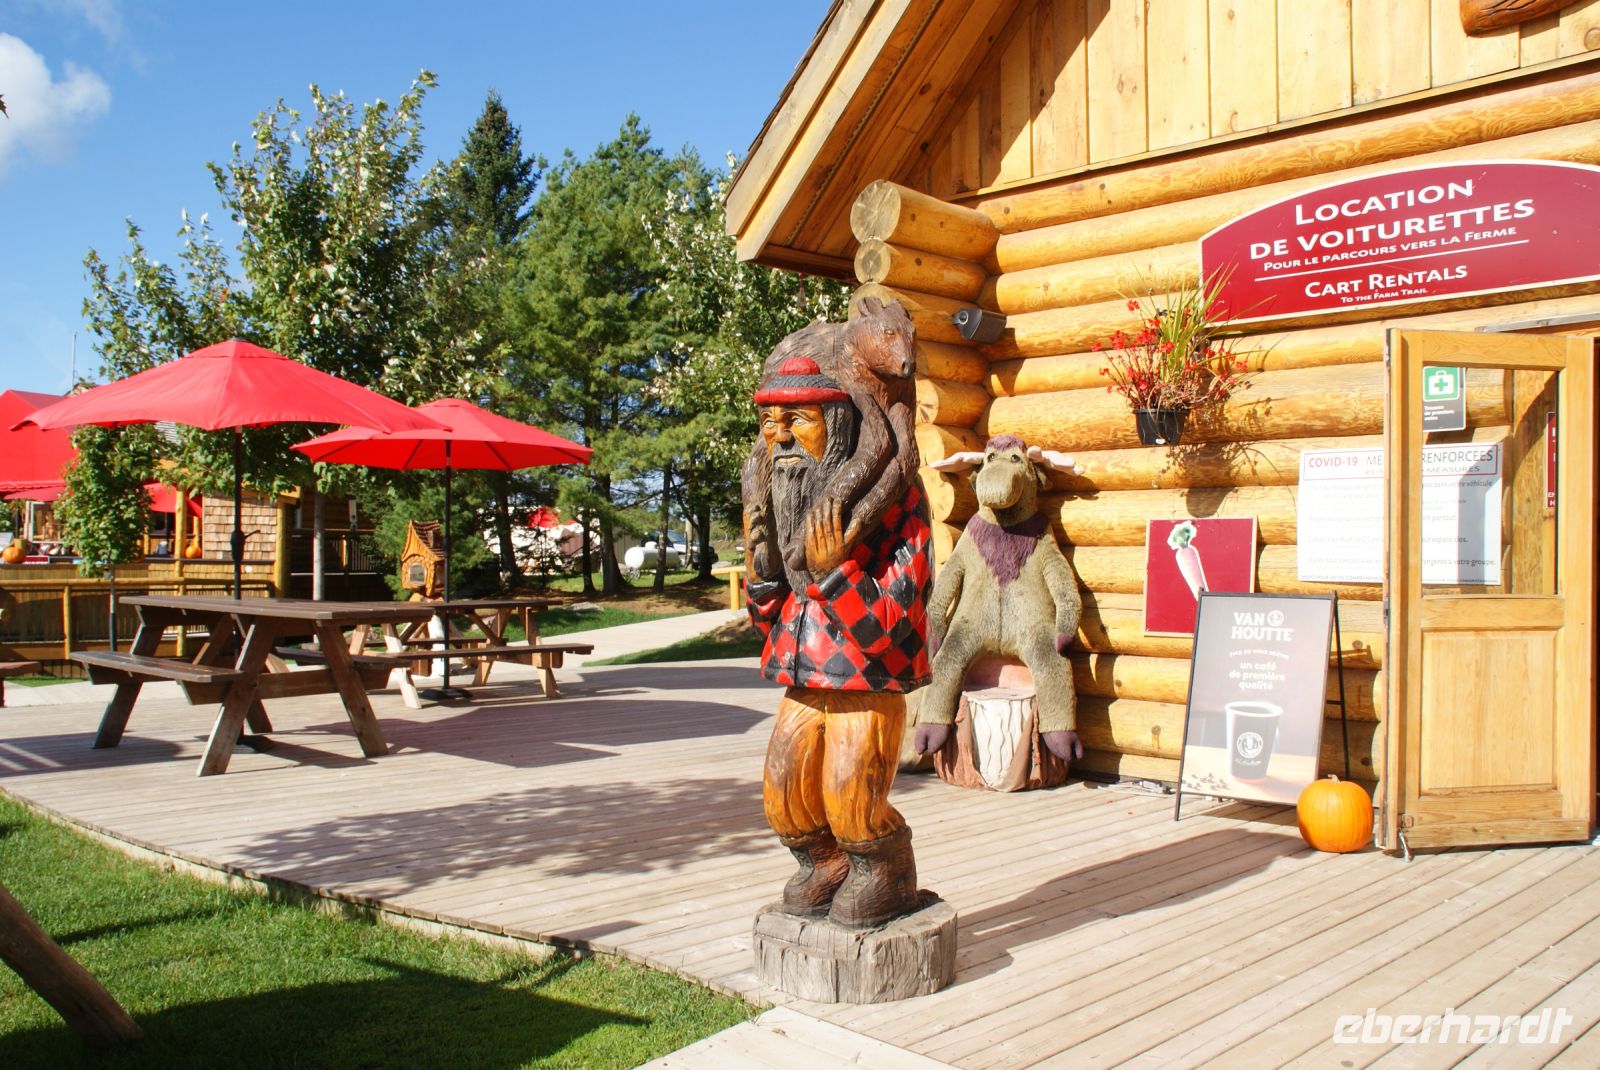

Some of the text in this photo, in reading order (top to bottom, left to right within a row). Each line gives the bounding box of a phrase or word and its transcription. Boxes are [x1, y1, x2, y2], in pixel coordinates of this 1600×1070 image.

[1296, 179, 1473, 225] LOCATION
[1250, 199, 1535, 260] DE VOITURETTES
[1263, 227, 1517, 272] POUR LE PARCOURS VERS LA FERME
[1304, 265, 1468, 298] CART RENTALS
[1341, 288, 1428, 304] TO THE FARM TRAIL
[1233, 612, 1265, 626] VAN
[1231, 625, 1295, 641] HOUTTE
[1254, 660, 1276, 671] café
[1229, 669, 1286, 681] de première
[1238, 680, 1273, 691] qualité
